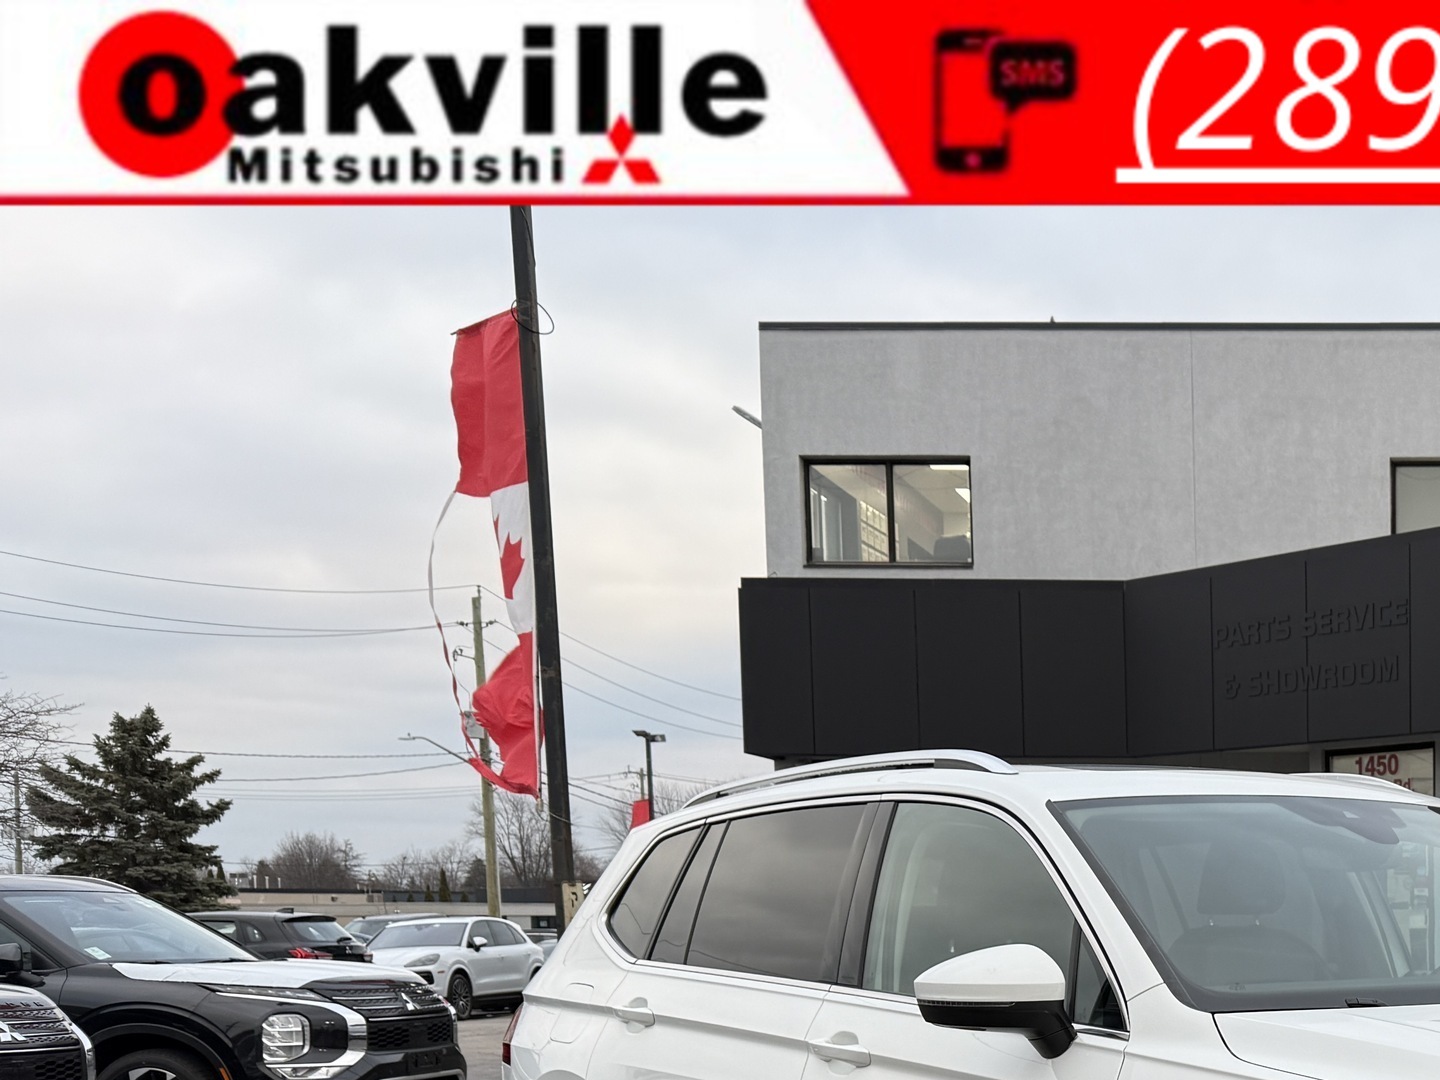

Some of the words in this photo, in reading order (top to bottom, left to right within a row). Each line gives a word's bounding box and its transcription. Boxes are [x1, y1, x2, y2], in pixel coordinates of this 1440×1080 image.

[1213, 614, 1292, 650] PARTS
[1301, 599, 1409, 638] SERVICE
[1225, 674, 1242, 700] &
[1248, 655, 1400, 698] SHOWROOM
[1355, 753, 1399, 777] 1450
